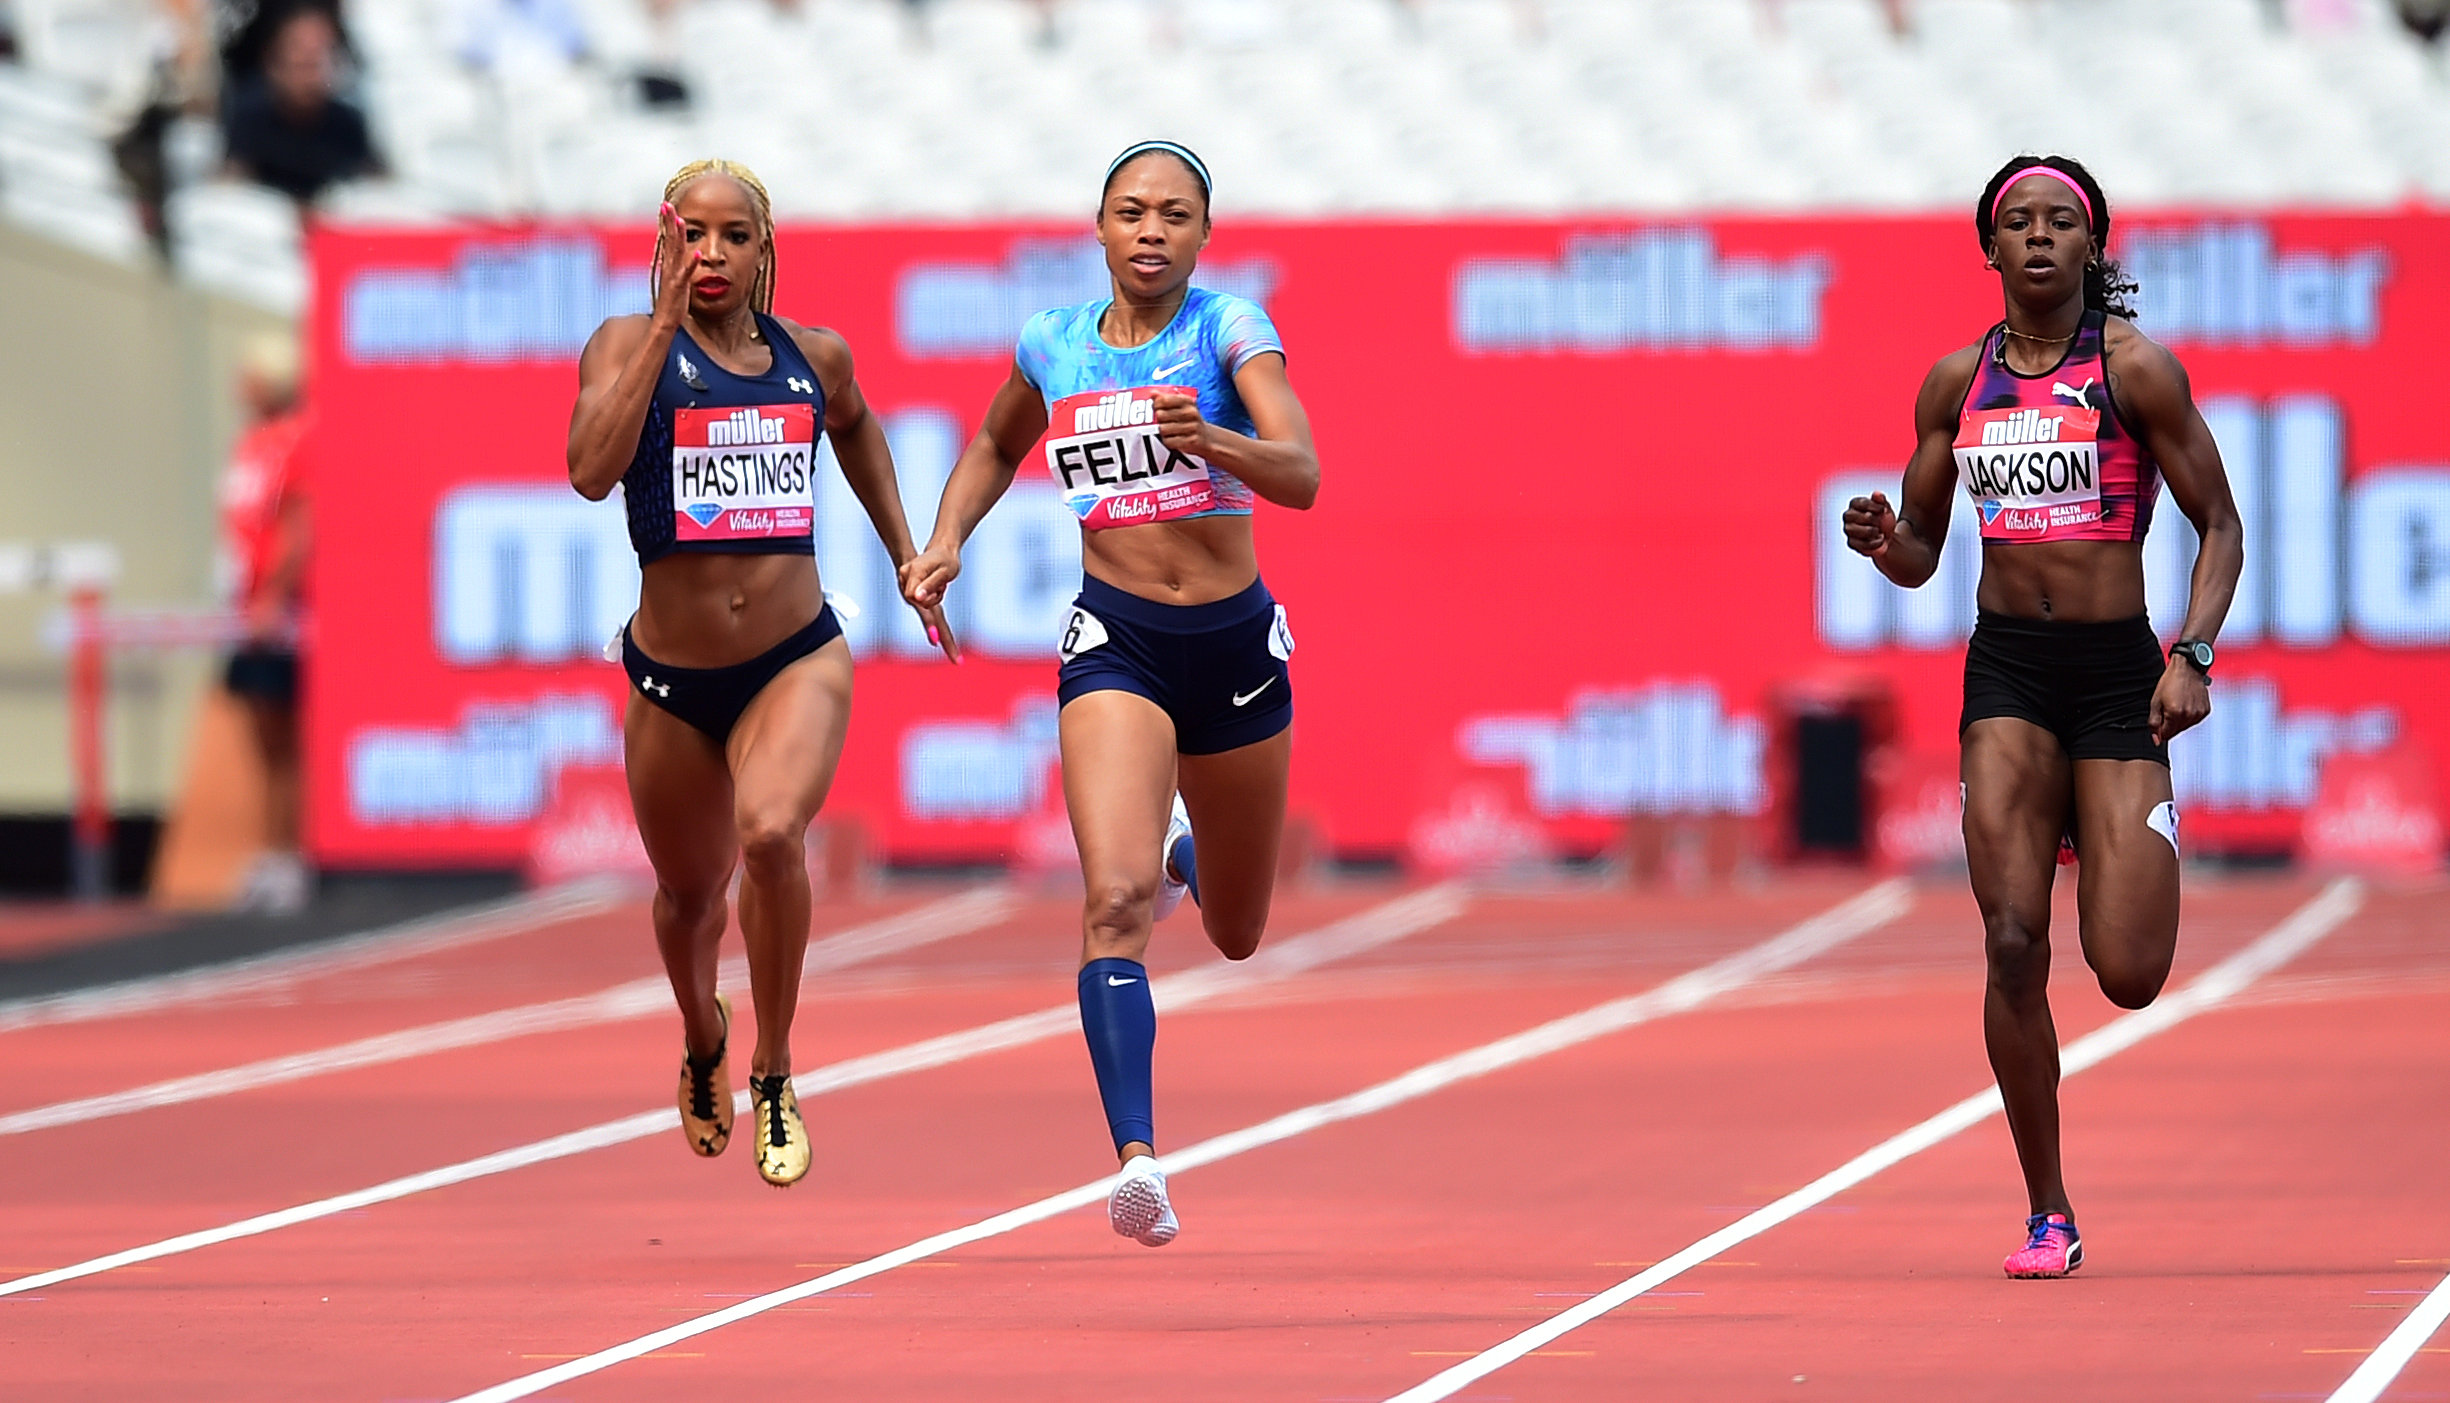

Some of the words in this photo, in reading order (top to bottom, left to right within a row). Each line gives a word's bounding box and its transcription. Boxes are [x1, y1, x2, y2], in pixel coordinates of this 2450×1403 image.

[708, 408, 786, 446] müller
[1981, 409, 2064, 446] müller
[682, 451, 805, 498] HASTINGS
[1055, 434, 1200, 489] FELIX
[1967, 450, 2092, 497] JACKSON
[1106, 496, 1158, 521] Vitality
[1157, 486, 1191, 502] HEALTH
[2049, 504, 2081, 517] HEALTH
[729, 509, 775, 536] Vitality
[2005, 508, 2048, 535] Vitality
[1062, 611, 1085, 654] 6
